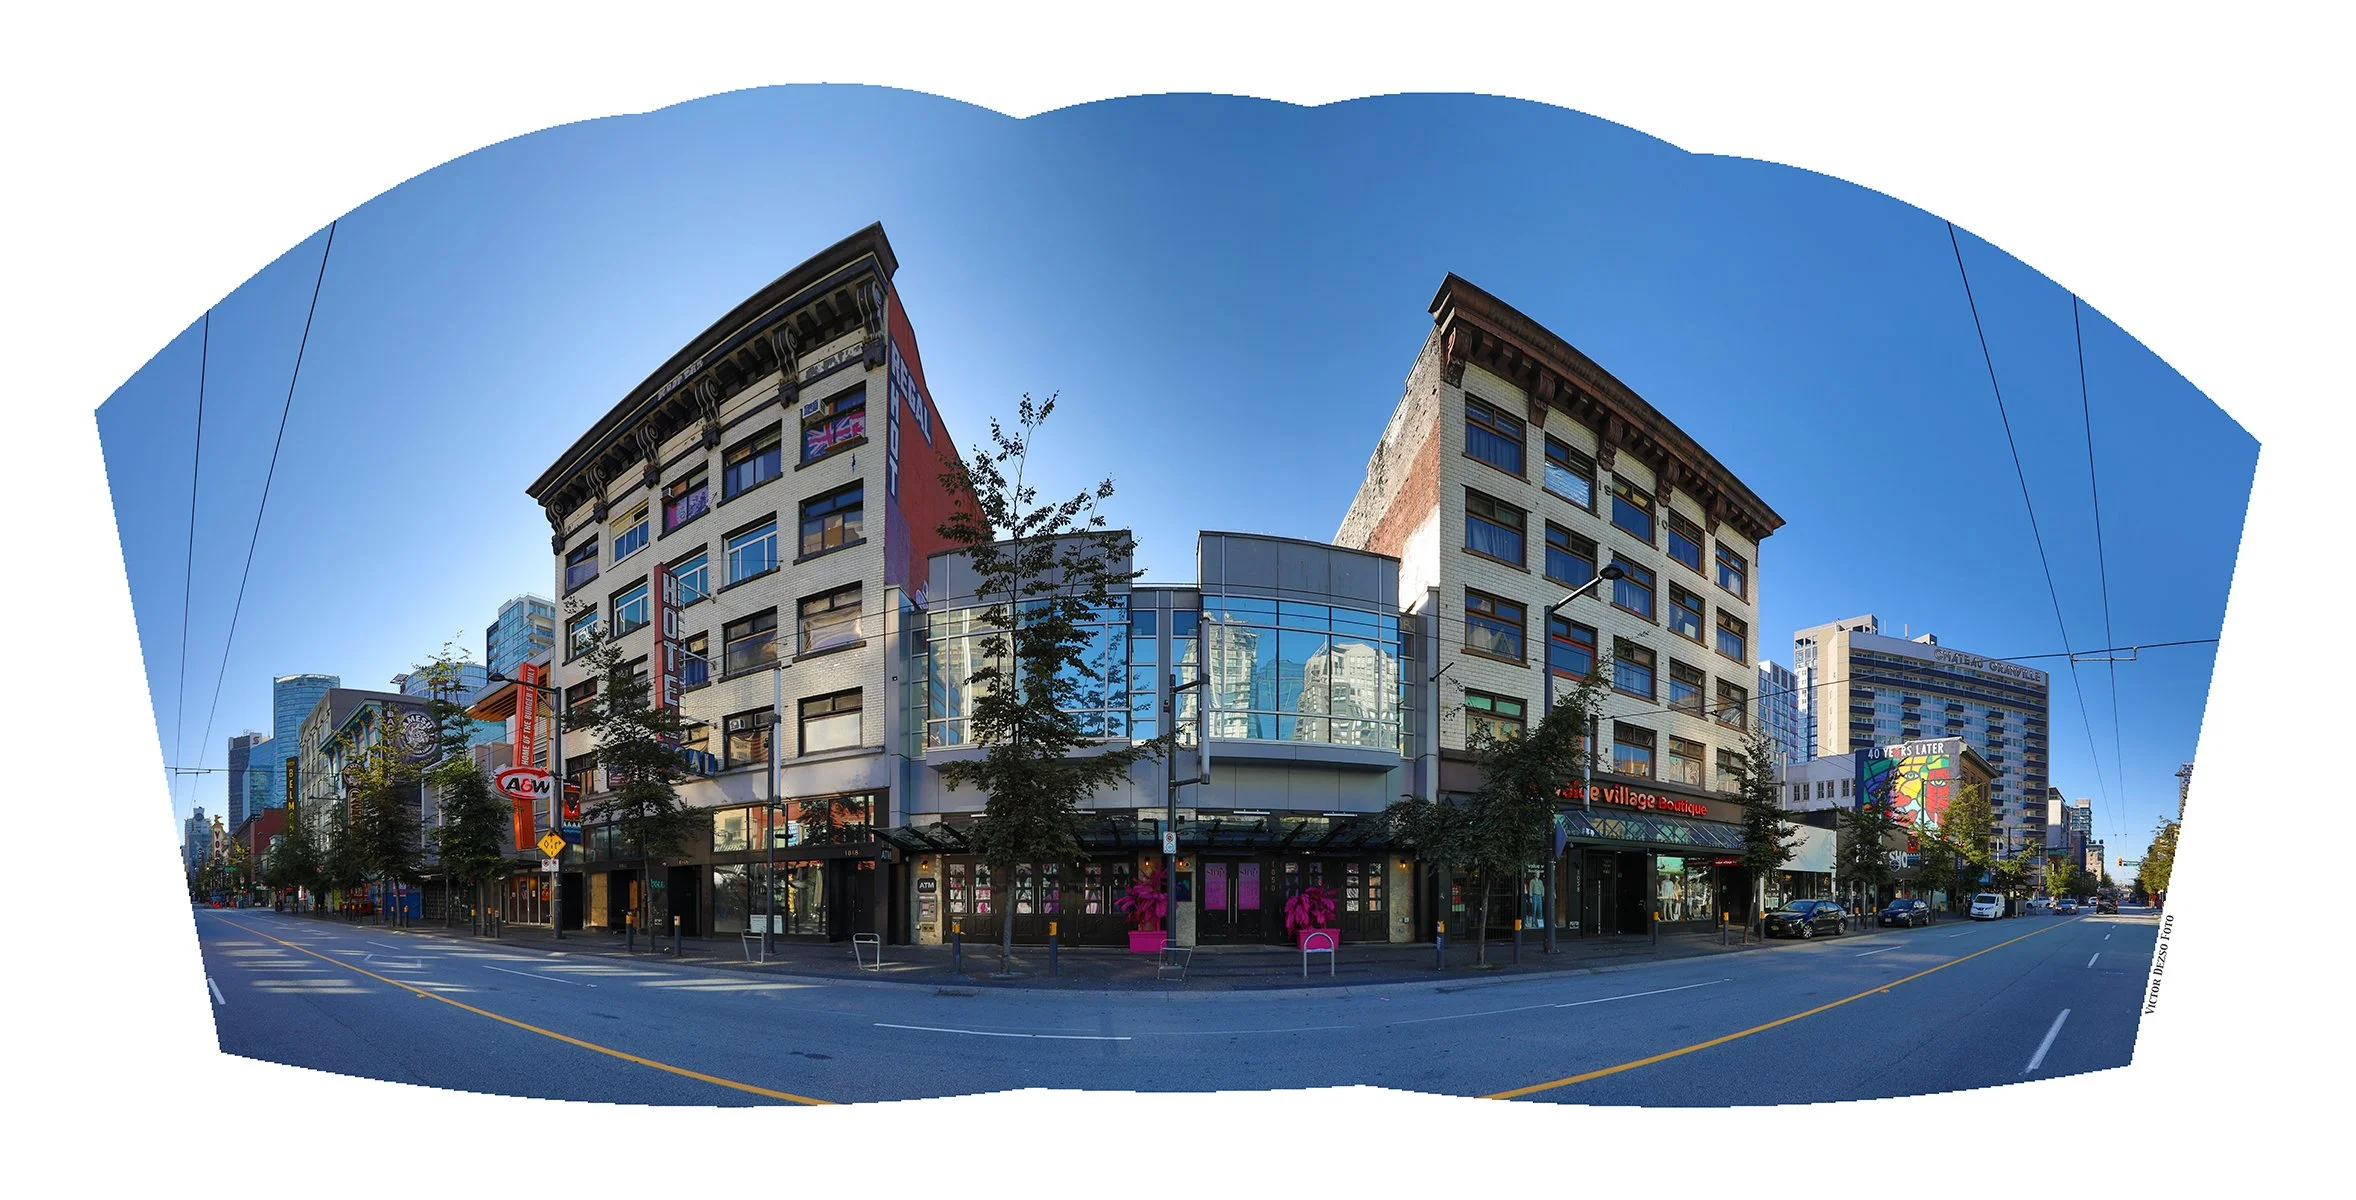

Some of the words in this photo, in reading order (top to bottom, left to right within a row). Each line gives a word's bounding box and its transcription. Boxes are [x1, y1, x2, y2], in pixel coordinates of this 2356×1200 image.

[891, 340, 931, 445] REGAL
[1598, 480, 1611, 496] 19
[1934, 648, 1984, 669] CHATEAU
[1989, 661, 2041, 682] GRANVILLE
[527, 666, 535, 690] FMILY
[525, 693, 533, 720] BURGER
[523, 720, 532, 734] THE
[523, 735, 531, 745] OF
[521, 745, 530, 765] HOME
[1868, 748, 1880, 759] 40
[1916, 743, 1944, 755] LATER
[505, 777, 550, 793] A&W
[1603, 783, 1655, 810] village
[1658, 795, 1708, 816] Boutique
